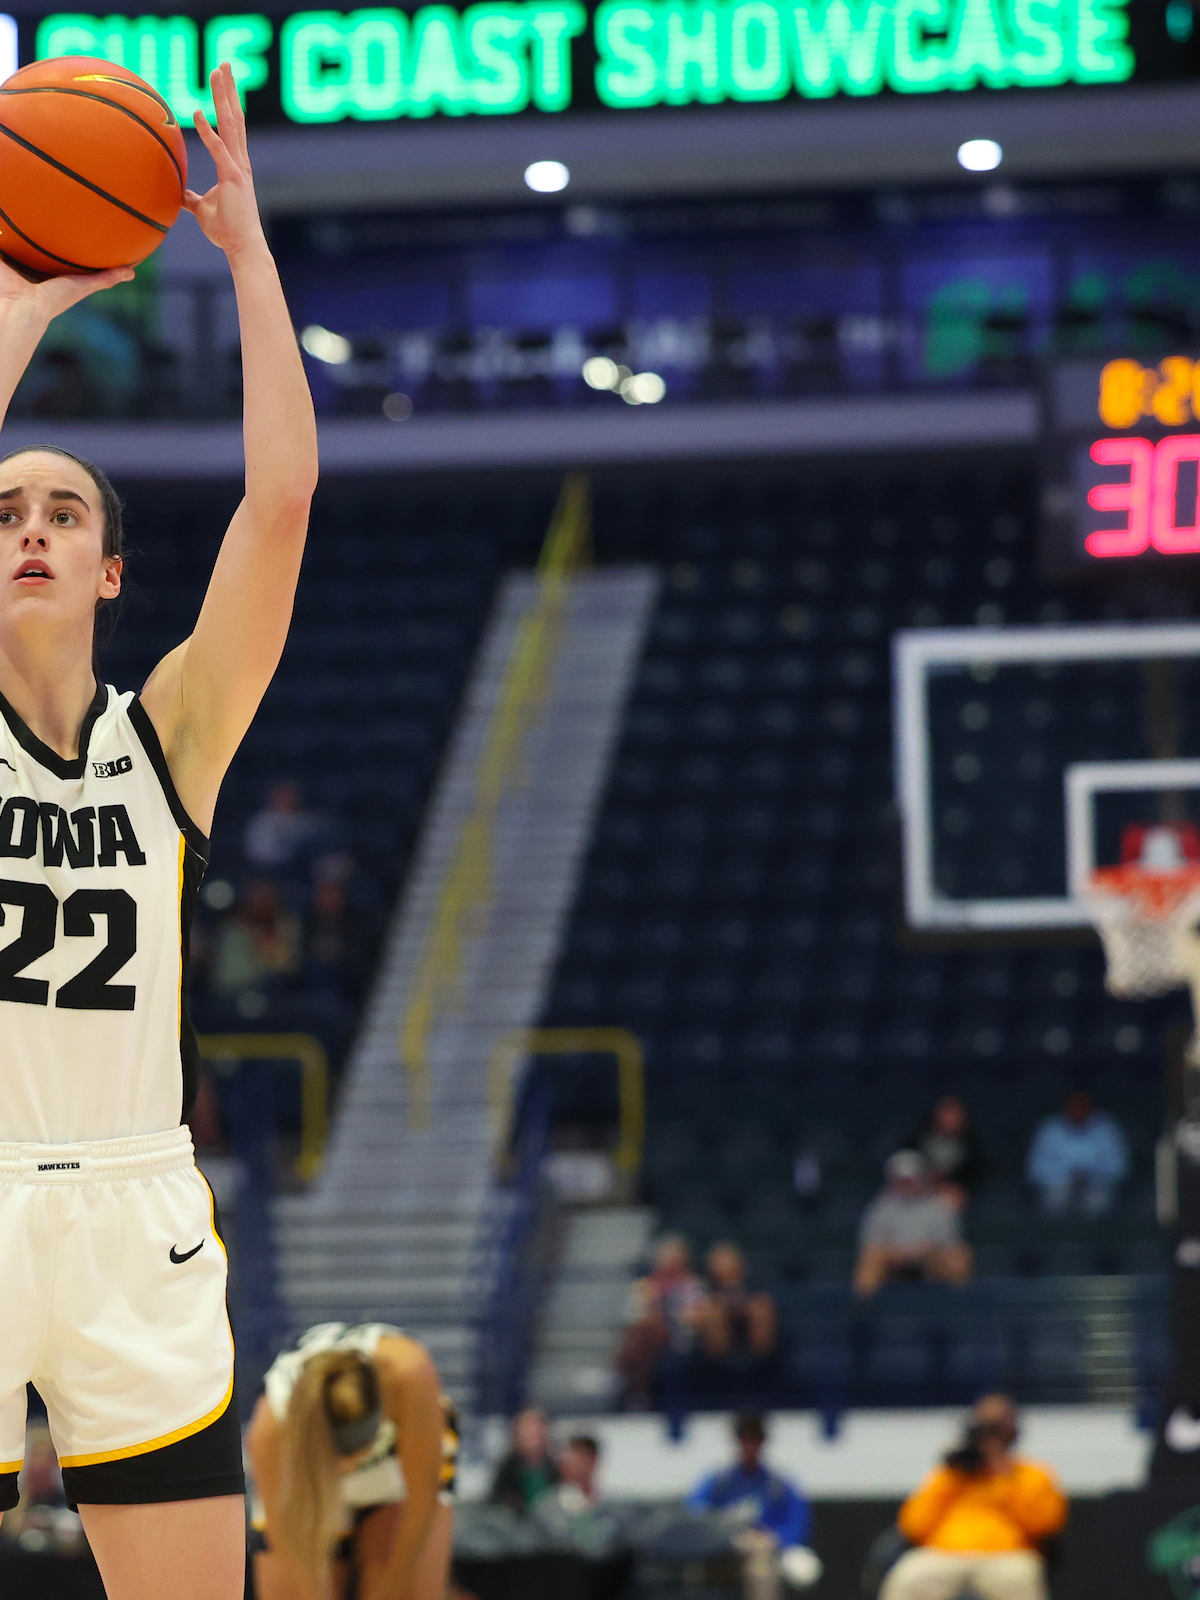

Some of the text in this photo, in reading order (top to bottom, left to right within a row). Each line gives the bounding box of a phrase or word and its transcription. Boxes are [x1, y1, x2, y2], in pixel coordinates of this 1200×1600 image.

[281, 1, 586, 124] COAST
[595, 0, 1134, 108] SHOWCASE
[1099, 355, 1200, 429] 8:2
[37, 1162, 81, 1172] HAWKEYES
